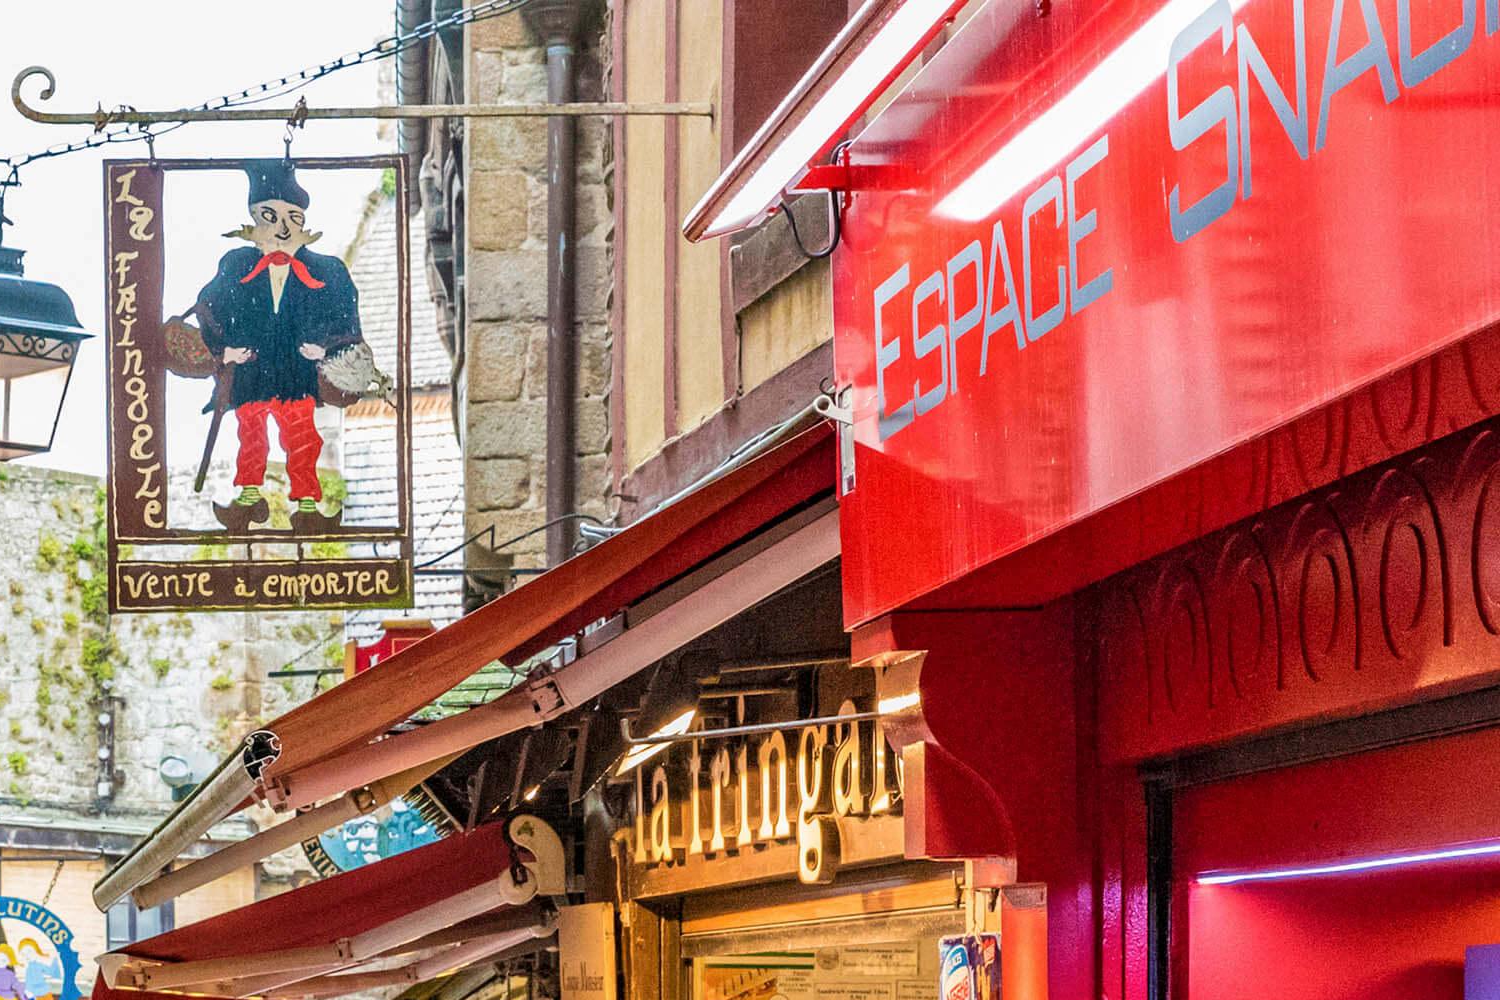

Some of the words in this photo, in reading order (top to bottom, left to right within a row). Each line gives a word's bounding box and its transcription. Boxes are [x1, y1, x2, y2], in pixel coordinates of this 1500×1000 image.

[873, 134, 1114, 442] ESPACE
[1167, 0, 1500, 243] SNA
[689, 695, 904, 884] fringal
